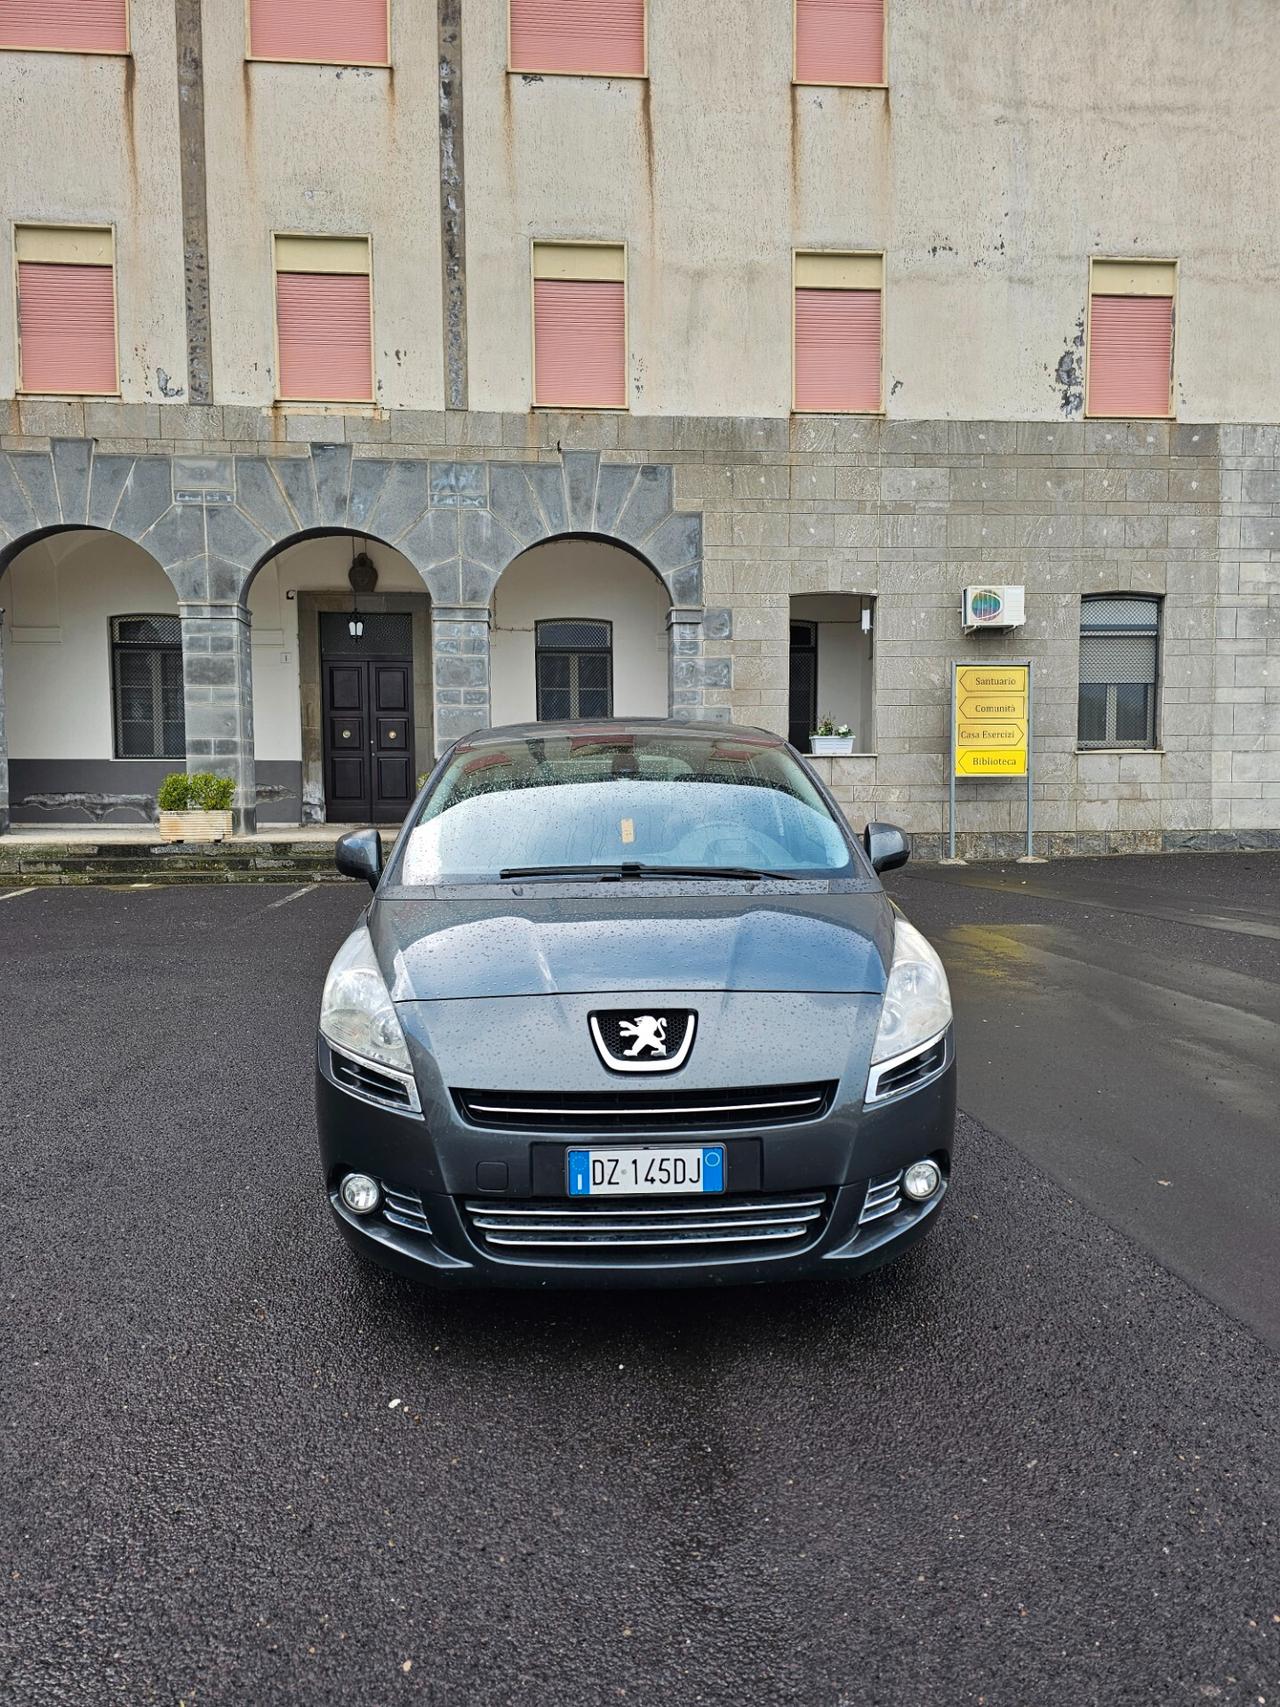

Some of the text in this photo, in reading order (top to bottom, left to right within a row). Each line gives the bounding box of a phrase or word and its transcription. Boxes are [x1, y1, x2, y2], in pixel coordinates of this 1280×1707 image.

[975, 677, 1016, 686] Santuario
[975, 704, 1016, 713] Comunità
[960, 730, 1015, 739] Casa Esercizi
[972, 757, 1017, 766] Biblioteca
